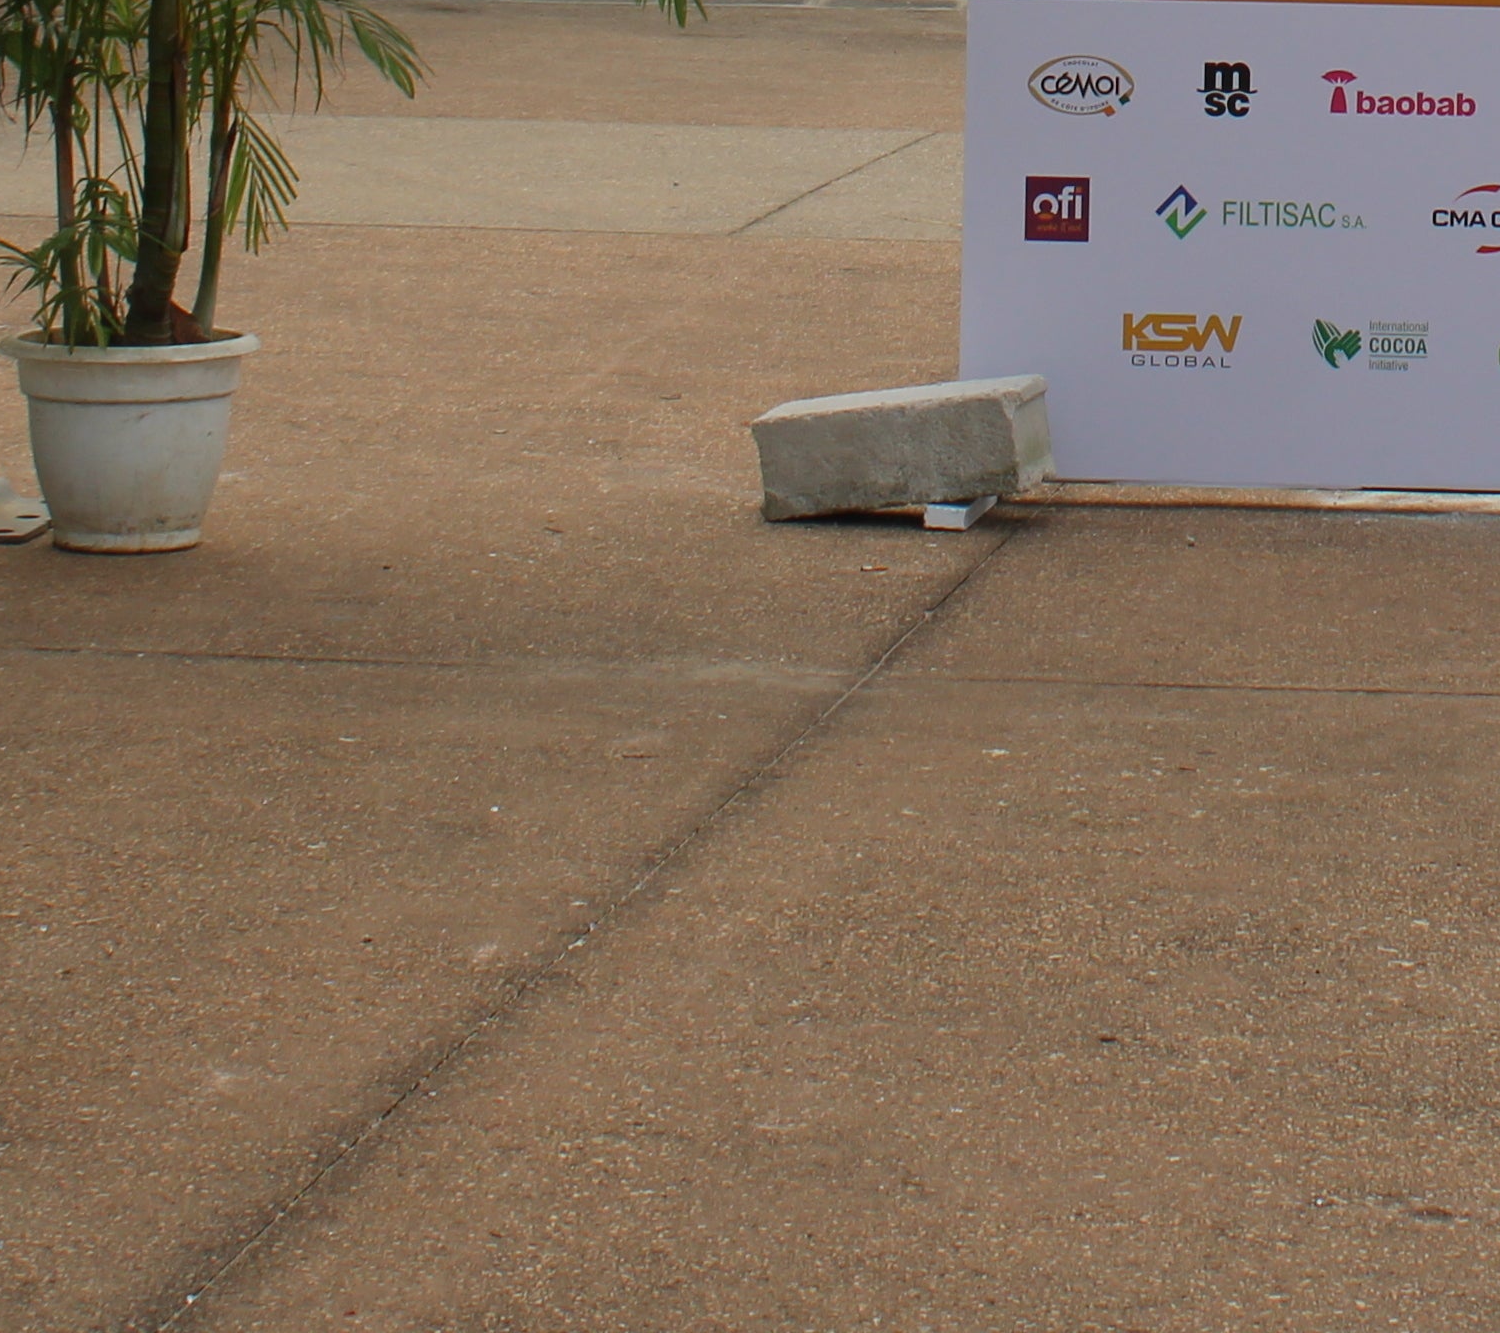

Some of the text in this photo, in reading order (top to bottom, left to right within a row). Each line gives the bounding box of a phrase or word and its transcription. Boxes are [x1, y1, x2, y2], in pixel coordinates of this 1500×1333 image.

[1356, 91, 1477, 117] baobab
[1033, 186, 1082, 219] ofi
[1222, 201, 1367, 229] FILTISAC S.A.
[1432, 210, 1486, 229] CMA
[1122, 313, 1243, 353] KSW
[1369, 320, 1429, 332] International
[1369, 337, 1427, 354] COCOA
[1131, 354, 1232, 369] GLOBAL
[1369, 359, 1409, 371] Initiative
